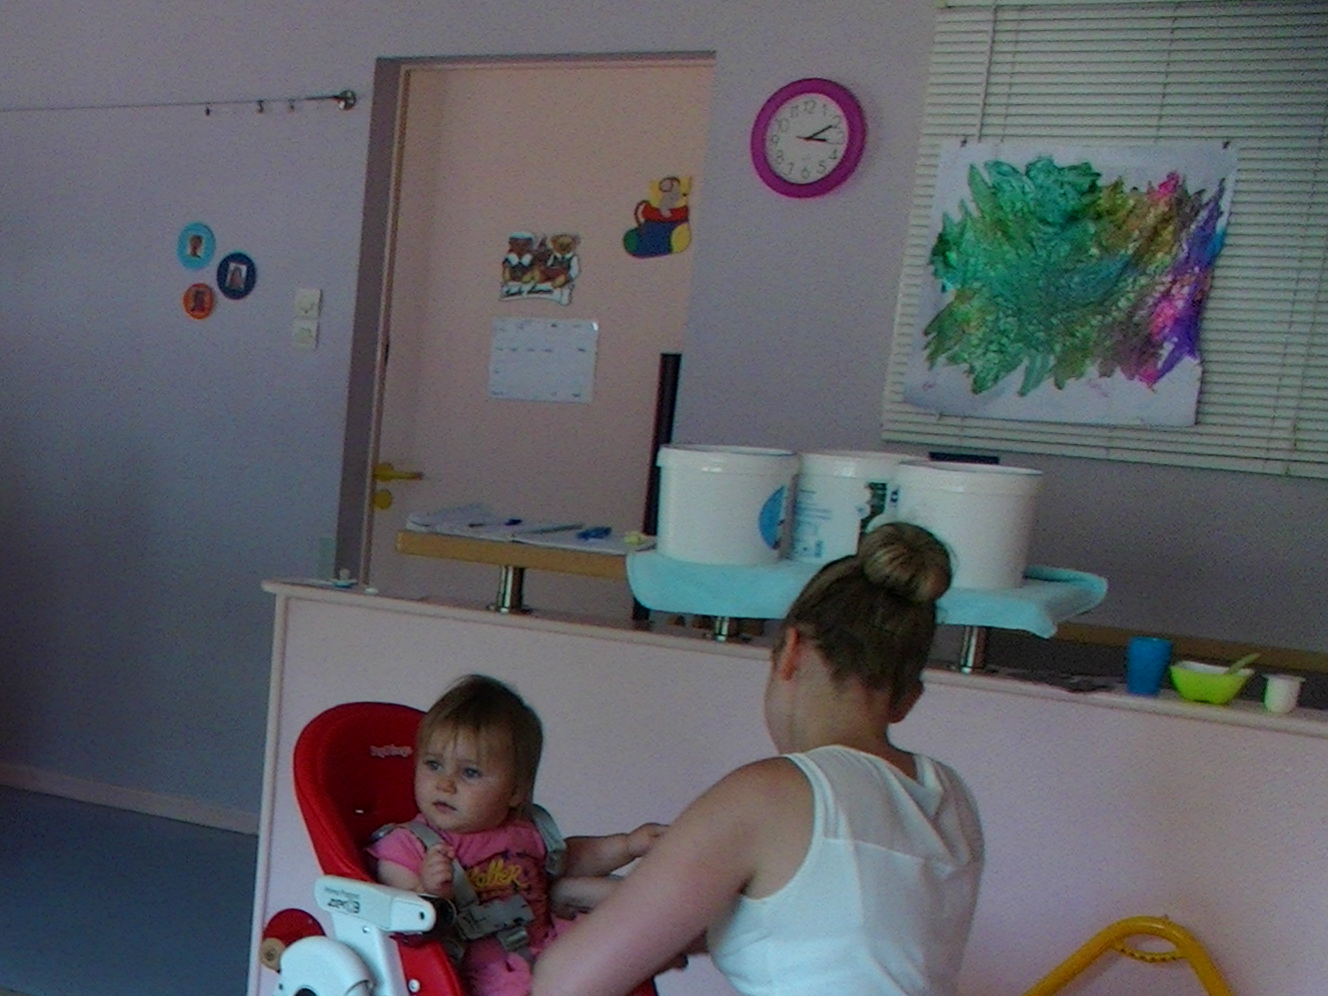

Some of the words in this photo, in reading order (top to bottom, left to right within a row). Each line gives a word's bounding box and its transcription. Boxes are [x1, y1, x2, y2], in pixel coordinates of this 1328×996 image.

[803, 99, 817, 114] 12
[800, 165, 811, 180] 6
[816, 160, 827, 175] 5
